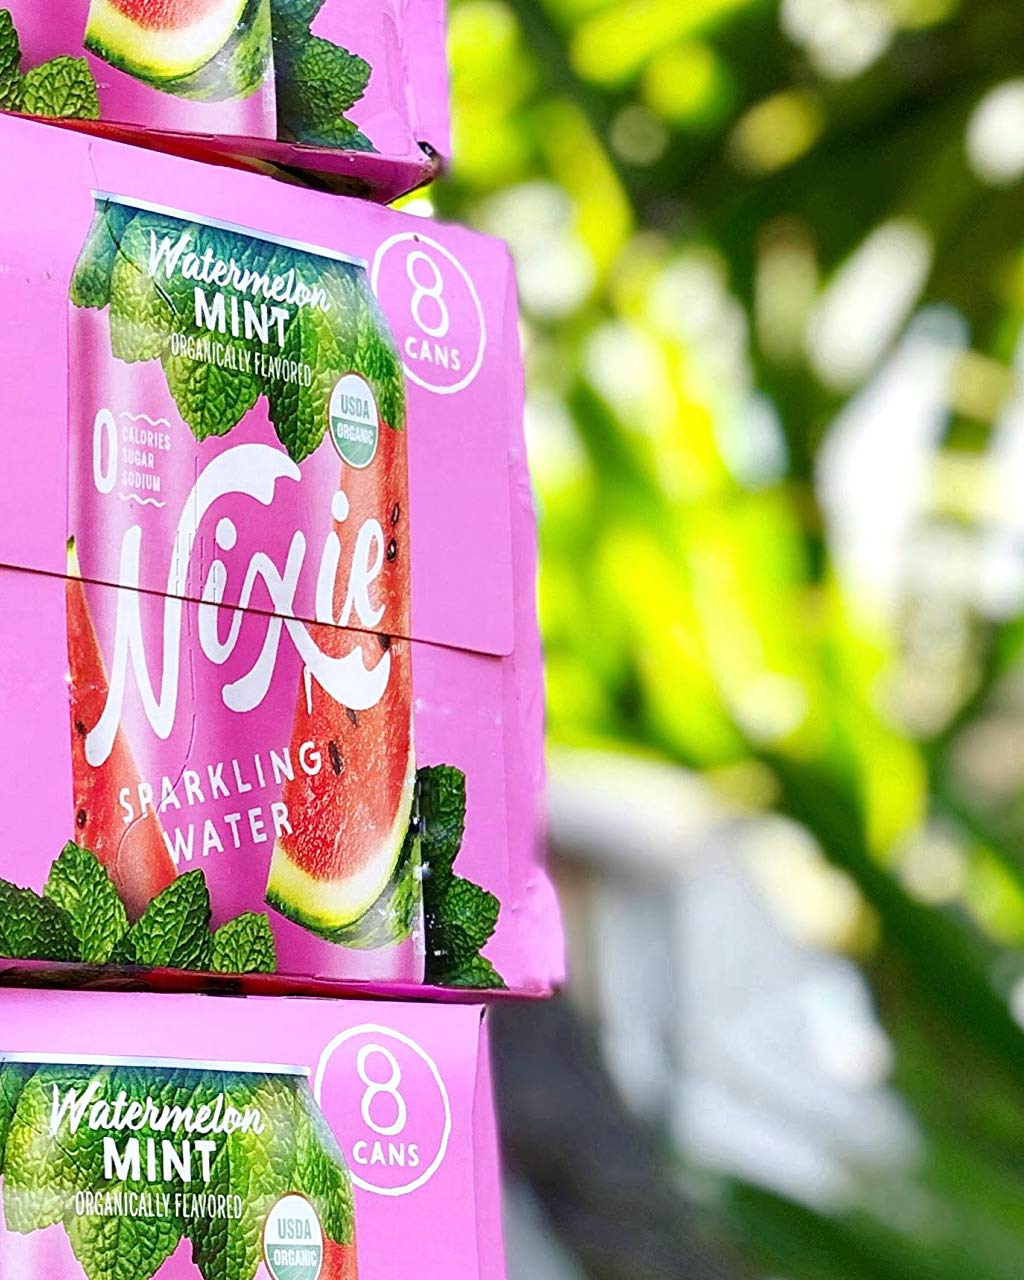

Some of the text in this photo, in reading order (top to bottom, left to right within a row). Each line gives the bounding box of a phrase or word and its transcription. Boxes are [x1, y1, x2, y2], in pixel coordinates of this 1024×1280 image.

[148, 229, 330, 312] Watermelon
[406, 250, 448, 338] 8
[193, 287, 290, 347] MINT
[171, 332, 311, 388] ORGANICALLY FLAVORED
[404, 337, 461, 371] CANS
[339, 393, 370, 421] USDA
[92, 408, 118, 494] 0
[120, 425, 172, 451] CALORIES
[120, 447, 154, 468] SUGAR
[335, 421, 374, 447] ORGANIC
[120, 471, 162, 493] SODIUM
[84, 443, 391, 768] Nixie
[118, 741, 322, 823] SPARKLING
[163, 808, 295, 865] WATER
[50, 1081, 266, 1137] Watermelon
[356, 1043, 407, 1136] 8
[103, 1136, 217, 1183] MINT
[352, 1140, 420, 1168] CANS
[75, 1191, 243, 1220] ORGANICALLY FLAVORED
[276, 1218, 313, 1240] USDA
[272, 1248, 317, 1268] ORGANIC
